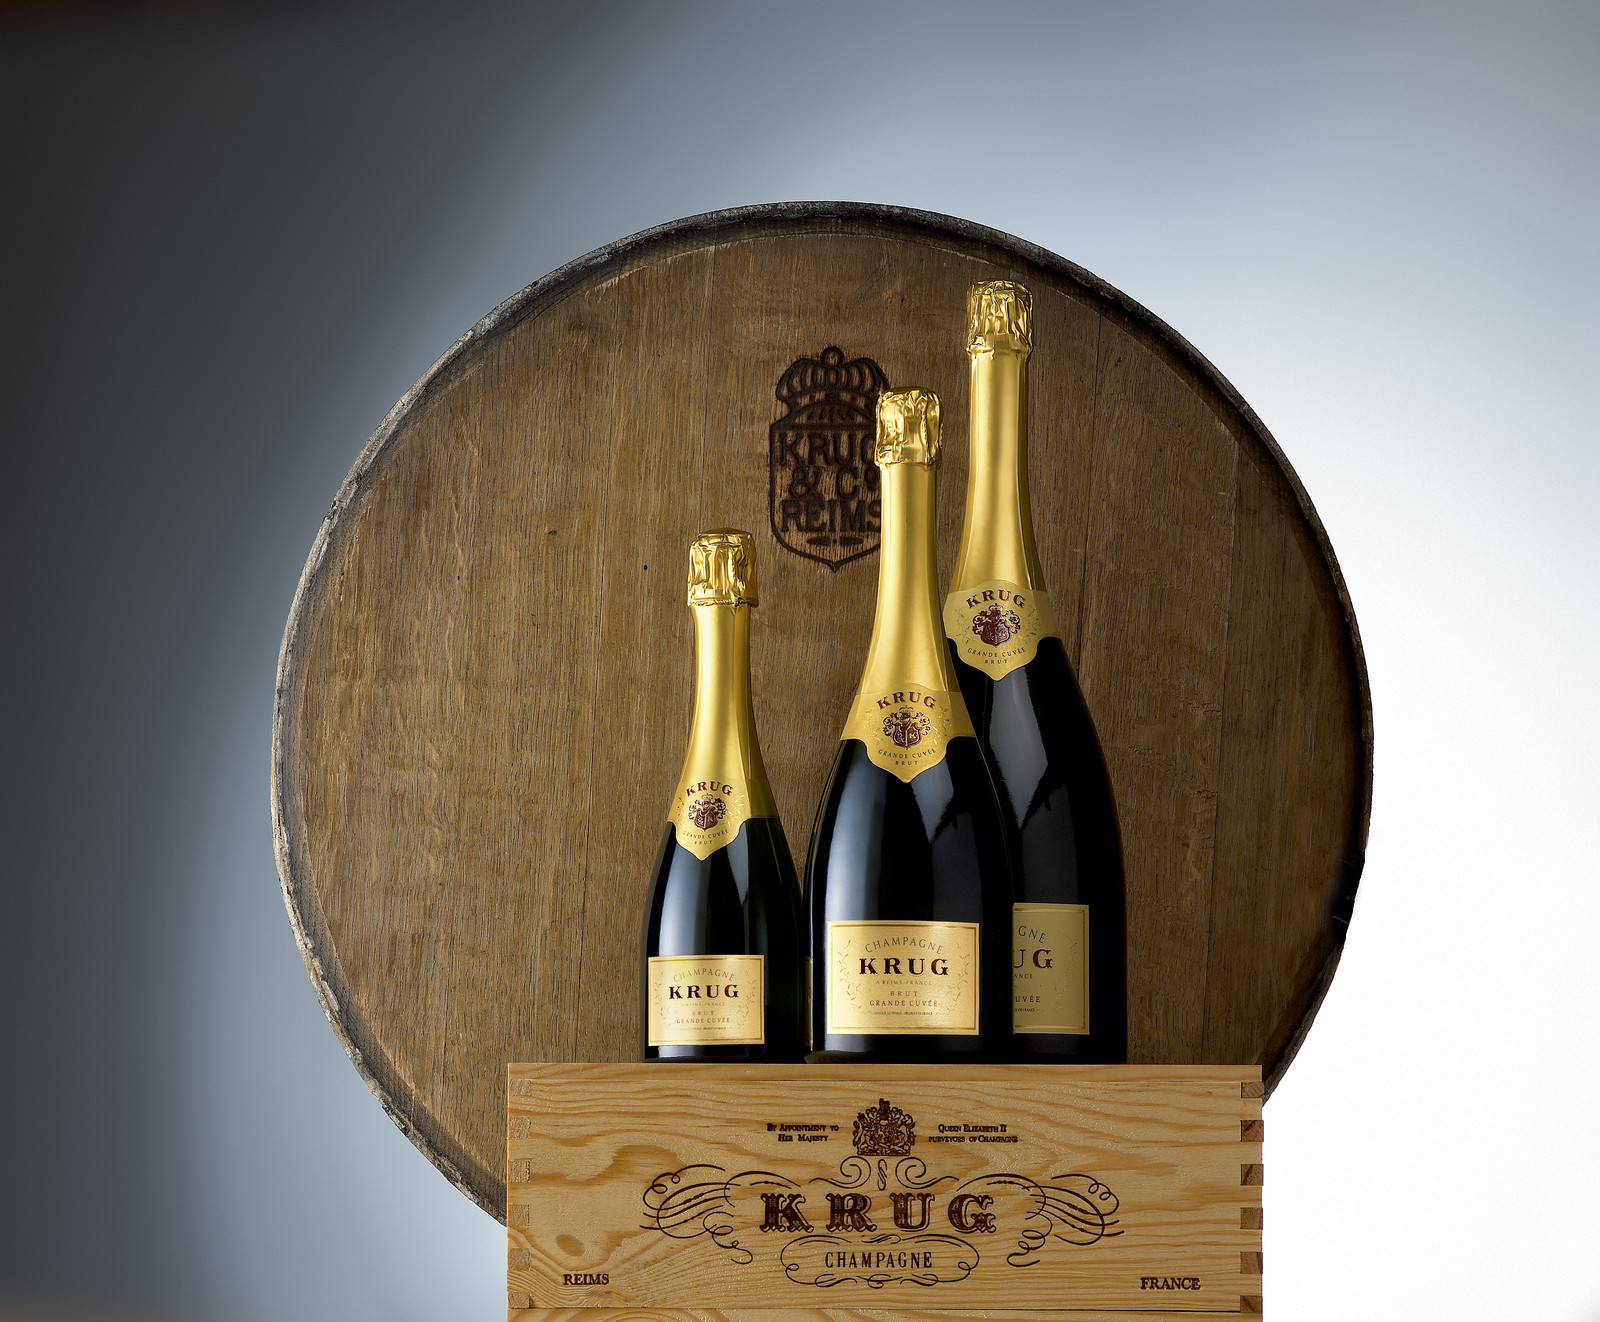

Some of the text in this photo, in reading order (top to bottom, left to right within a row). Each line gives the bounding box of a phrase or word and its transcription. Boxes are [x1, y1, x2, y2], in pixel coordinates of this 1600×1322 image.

[789, 467, 823, 498] &
[966, 589, 1026, 609] KRUG
[967, 648, 998, 658] GRANDE
[876, 691, 936, 710] KRUG
[877, 749, 908, 759] GRANDE
[686, 781, 733, 797] KRUG
[865, 936, 944, 955] CHAMPAGNE
[859, 957, 949, 976] KRUG
[673, 968, 735, 982] CHAMPAGNE
[668, 984, 739, 1000] KRUG
[909, 999, 938, 1007] CUVÉE
[1015, 995, 1040, 1003] UVÉE
[767, 1123, 777, 1131] BY
[779, 1124, 827, 1132] APPOINTMENT
[938, 1123, 1007, 1133] QUEEN ELIZABETH II
[778, 1134, 829, 1143] HER MAJESTY
[977, 1135, 1018, 1143] CHAMPAGNE
[759, 1192, 997, 1234] KRUG
[825, 1251, 933, 1269] CHAMPAGNE
[563, 1273, 610, 1285] REIMS
[1140, 1277, 1201, 1290] FRANCE
